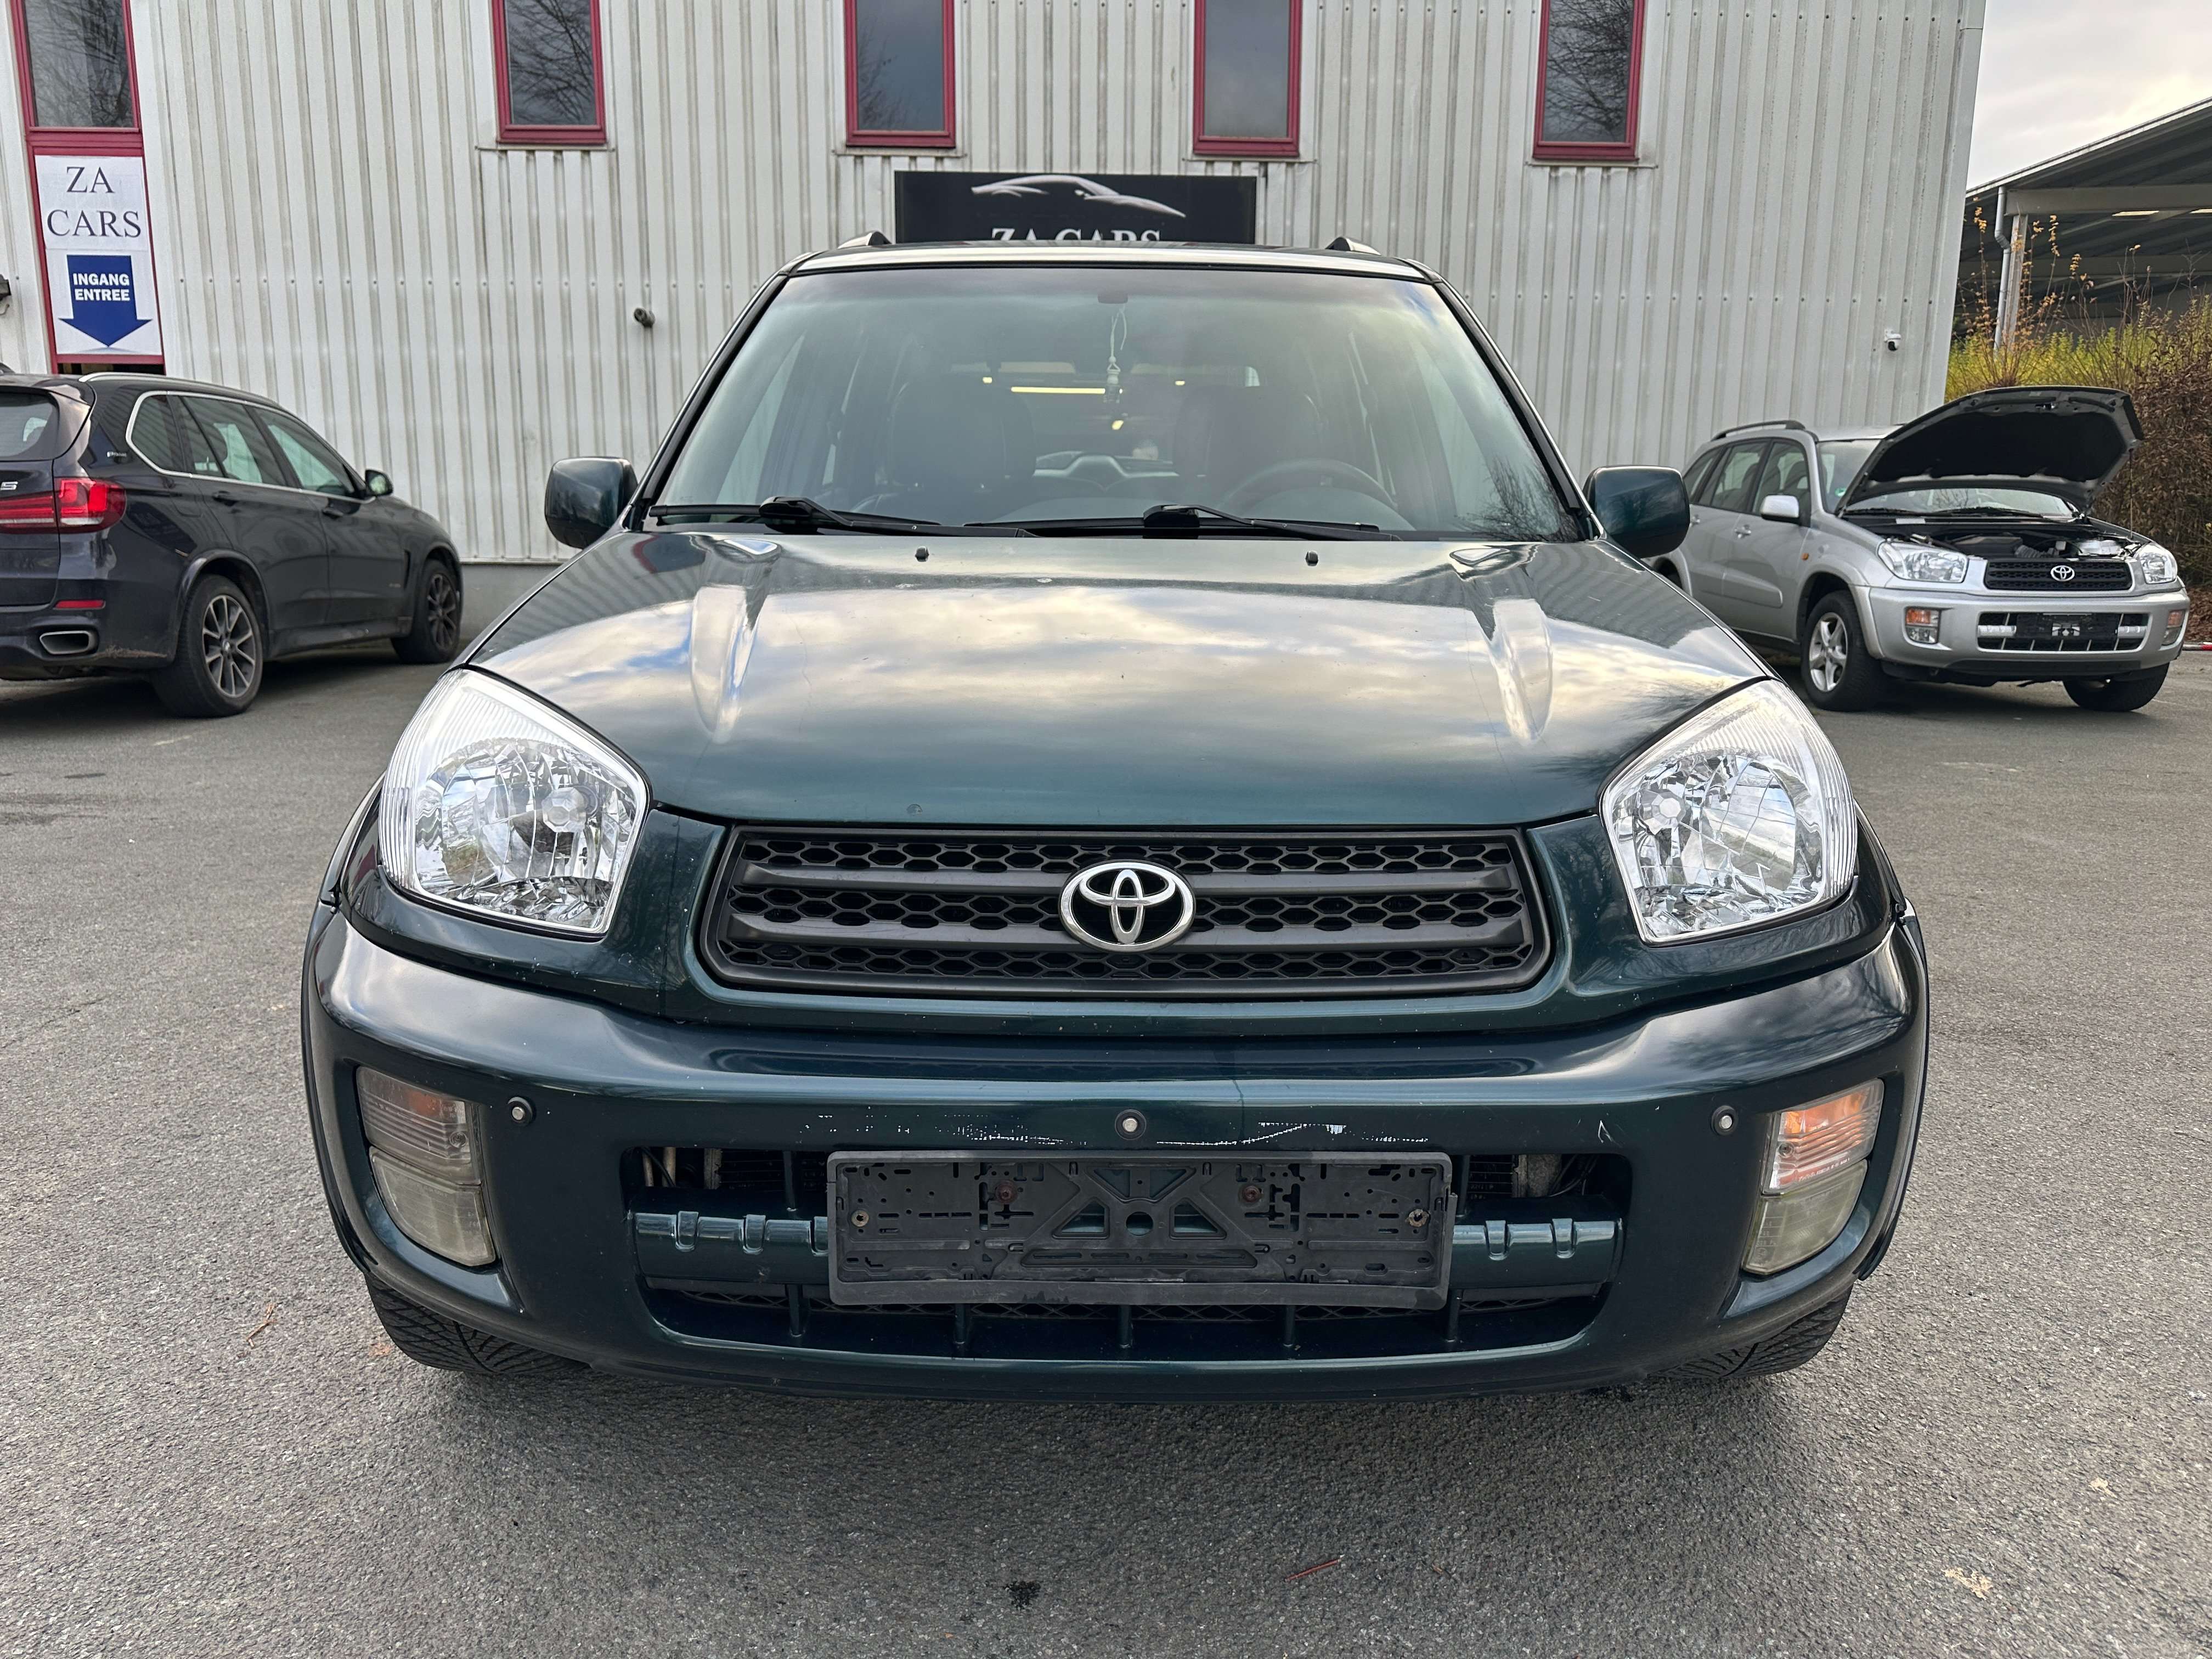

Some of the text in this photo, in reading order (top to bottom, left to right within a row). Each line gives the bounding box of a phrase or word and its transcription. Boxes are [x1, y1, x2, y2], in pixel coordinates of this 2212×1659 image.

[66, 166, 115, 193] ZA
[47, 209, 141, 238] CARS
[73, 273, 130, 286] INGANG
[75, 289, 131, 301] ENTREE
